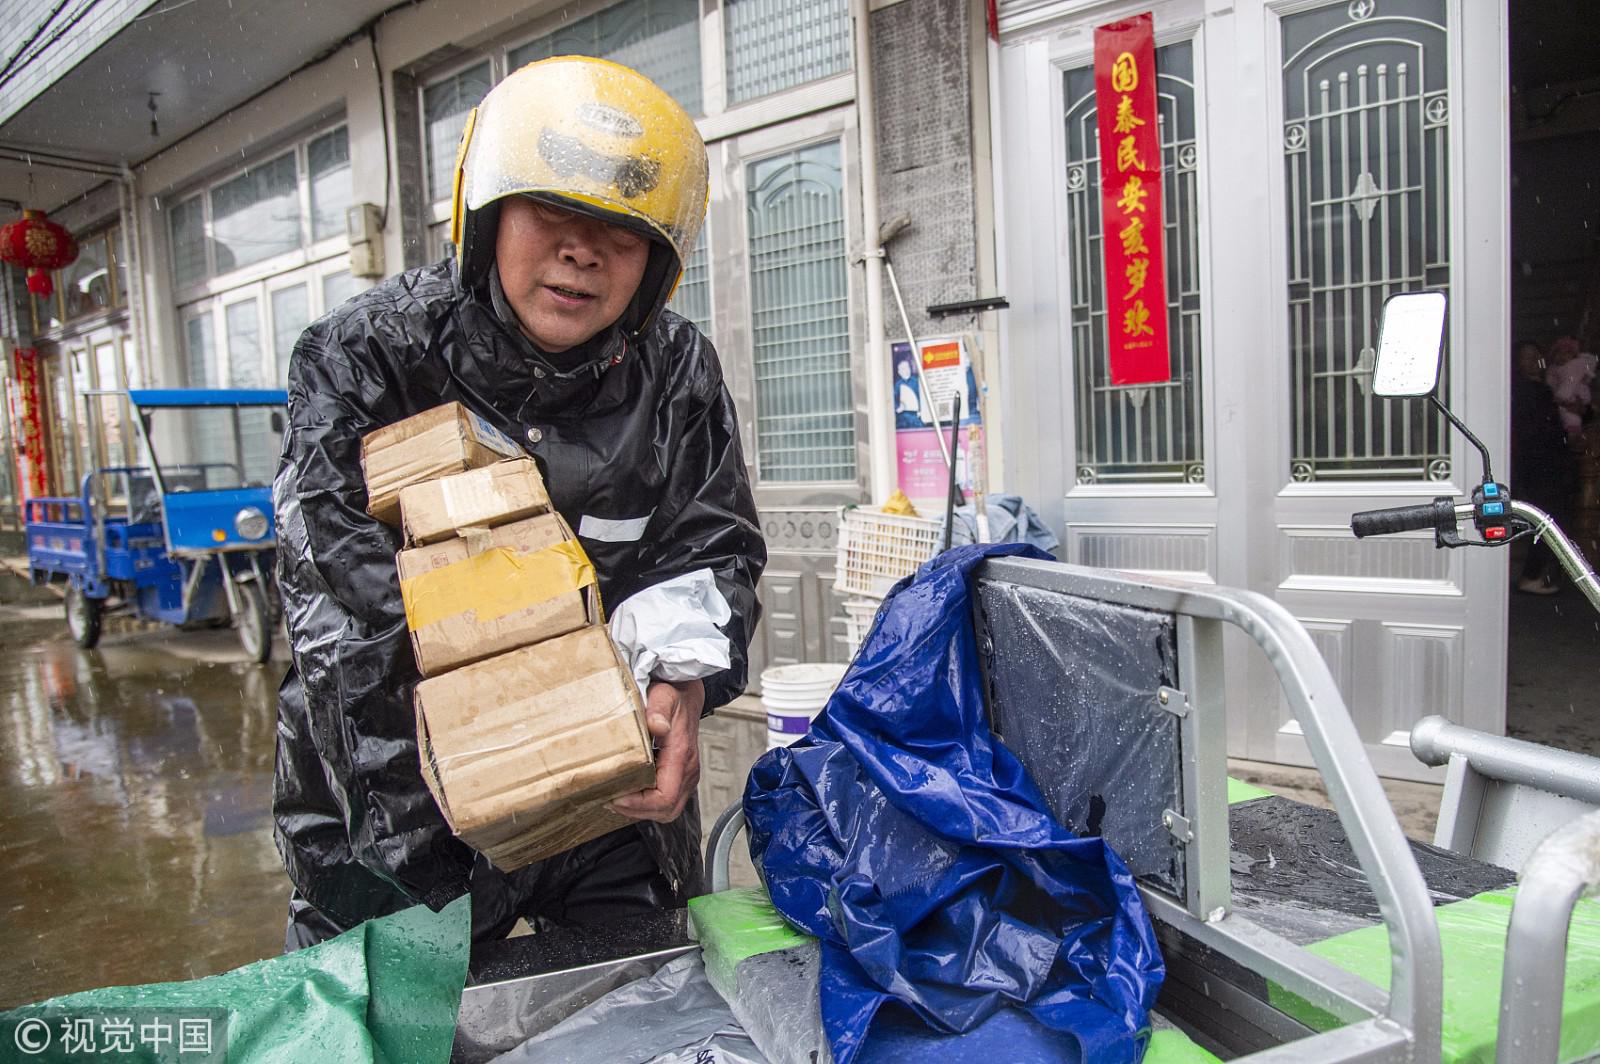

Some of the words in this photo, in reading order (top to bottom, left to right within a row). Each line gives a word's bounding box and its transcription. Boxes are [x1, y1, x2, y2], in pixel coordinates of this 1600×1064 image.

[1112, 52, 1155, 337] 国泰民安亥岁欢
